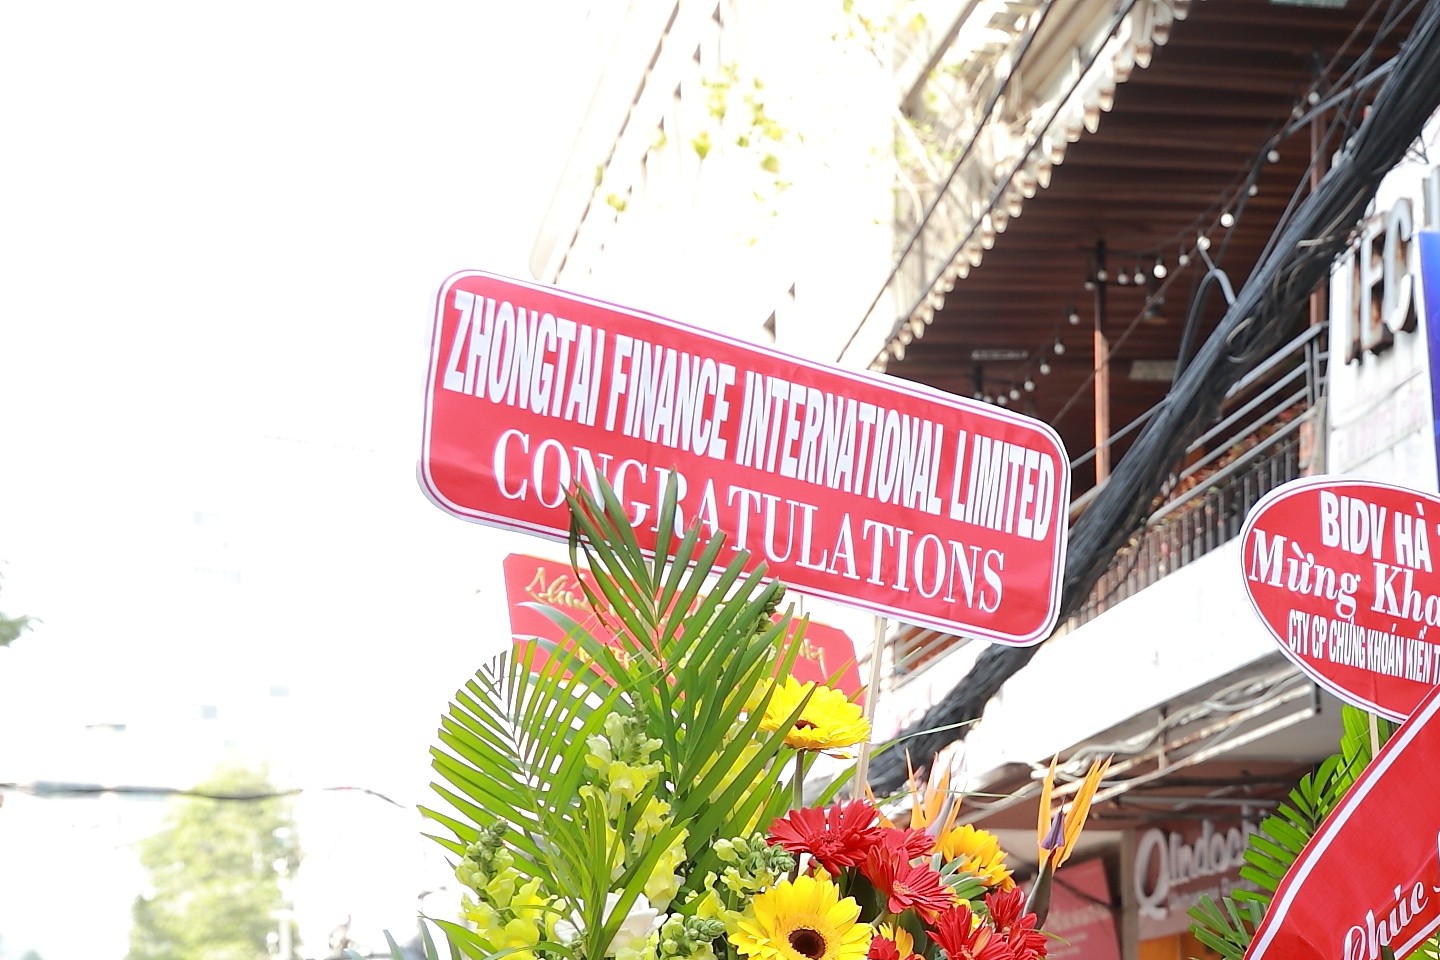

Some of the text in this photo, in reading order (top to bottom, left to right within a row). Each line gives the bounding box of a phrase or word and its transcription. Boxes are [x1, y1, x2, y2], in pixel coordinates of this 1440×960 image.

[443, 289, 1053, 541] ZHONGTAI FINANCE INTERNATIONAL LIMITED
[493, 428, 1005, 615] CONGRATULATIONS
[1320, 490, 1388, 559] BIDV
[1393, 502, 1433, 573] HÀ
[1248, 528, 1362, 620] Mừng
[1288, 609, 1312, 655] CTY
[1312, 616, 1328, 660] CP
[1367, 623, 1404, 679] KHOÁN
[1405, 624, 1433, 684] KIẾN
